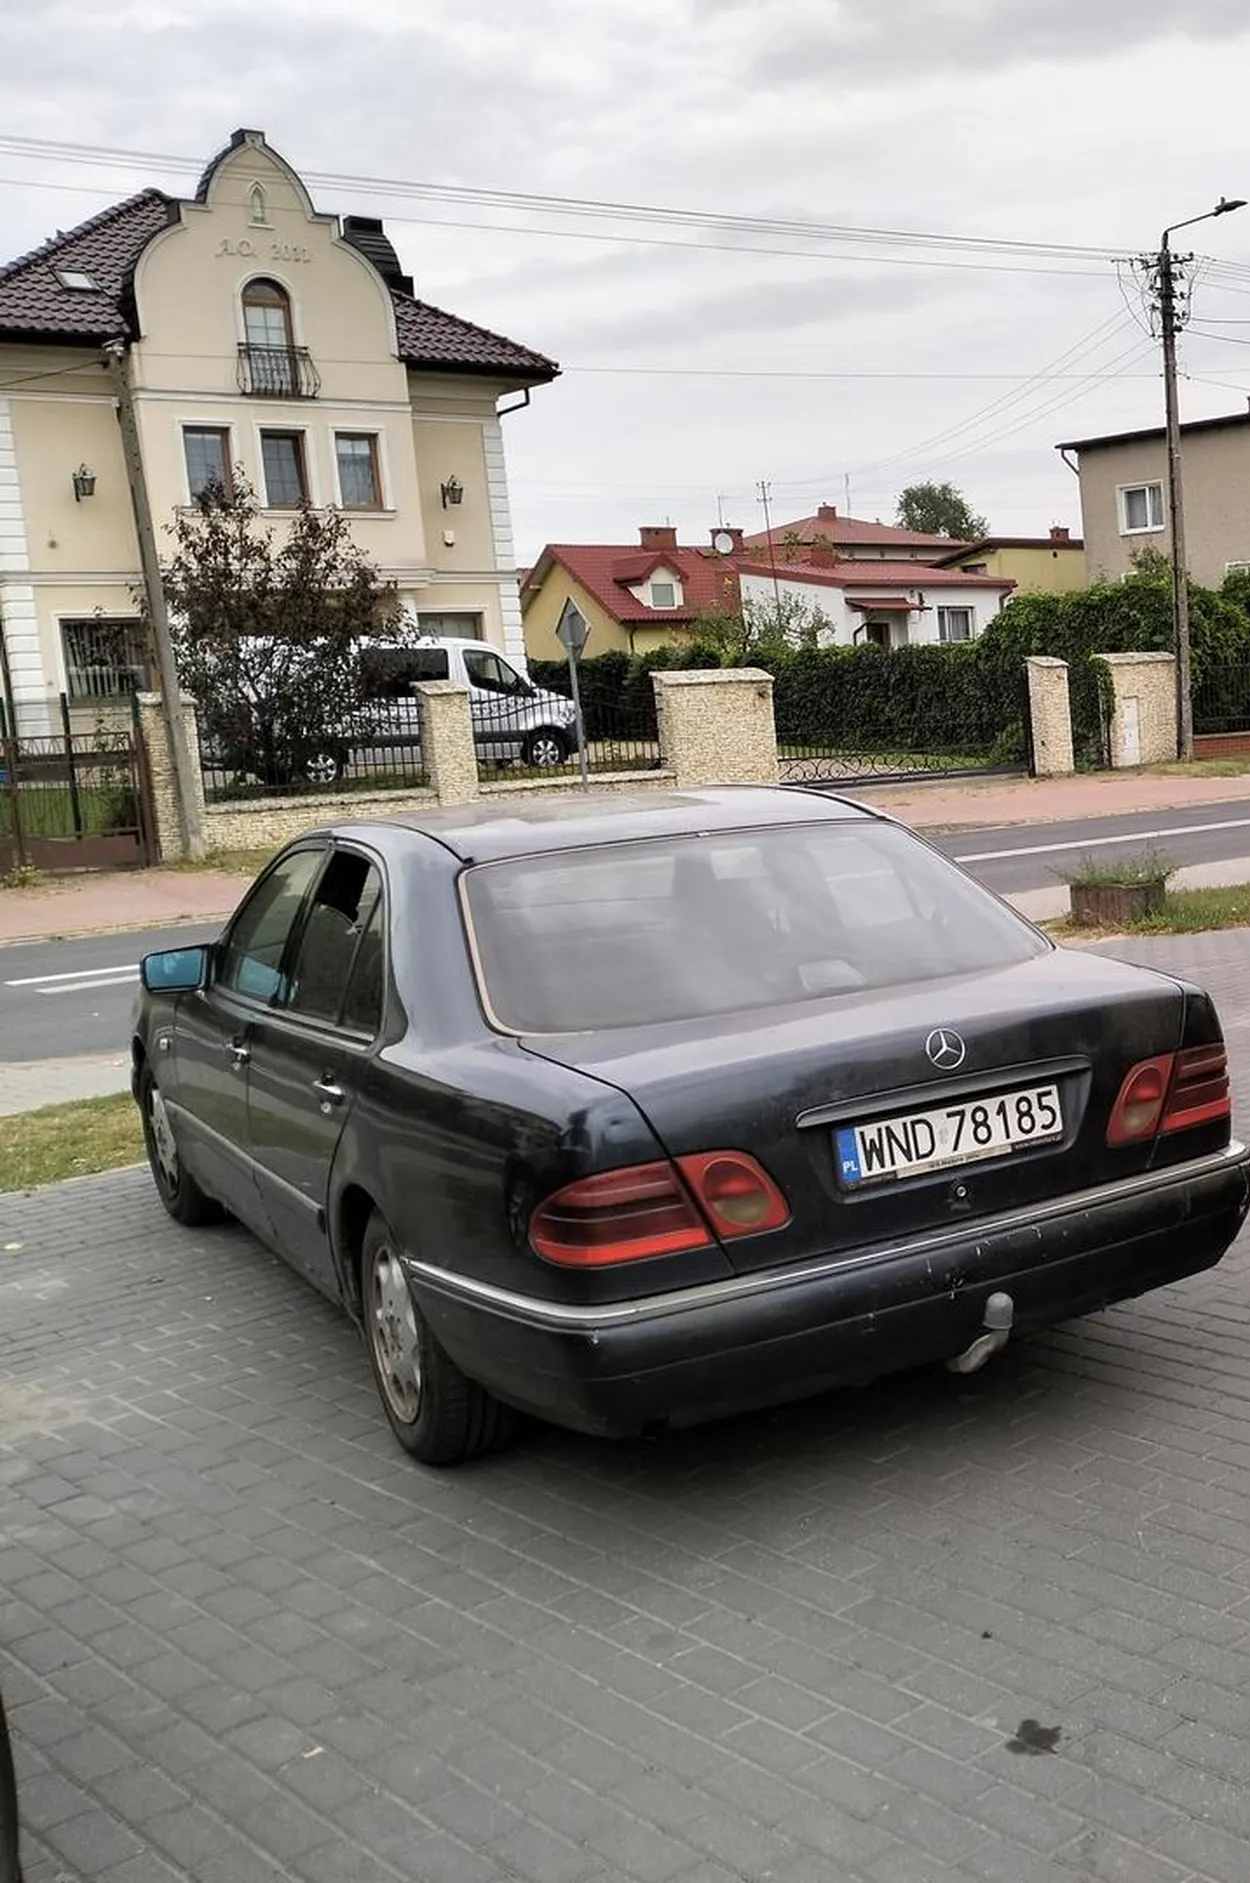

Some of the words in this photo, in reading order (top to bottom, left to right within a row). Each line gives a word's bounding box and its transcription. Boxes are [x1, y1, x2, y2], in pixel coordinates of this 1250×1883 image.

[860, 1118, 936, 1172] WND
[946, 1091, 1057, 1152] 78185
[842, 1160, 859, 1173] PL
